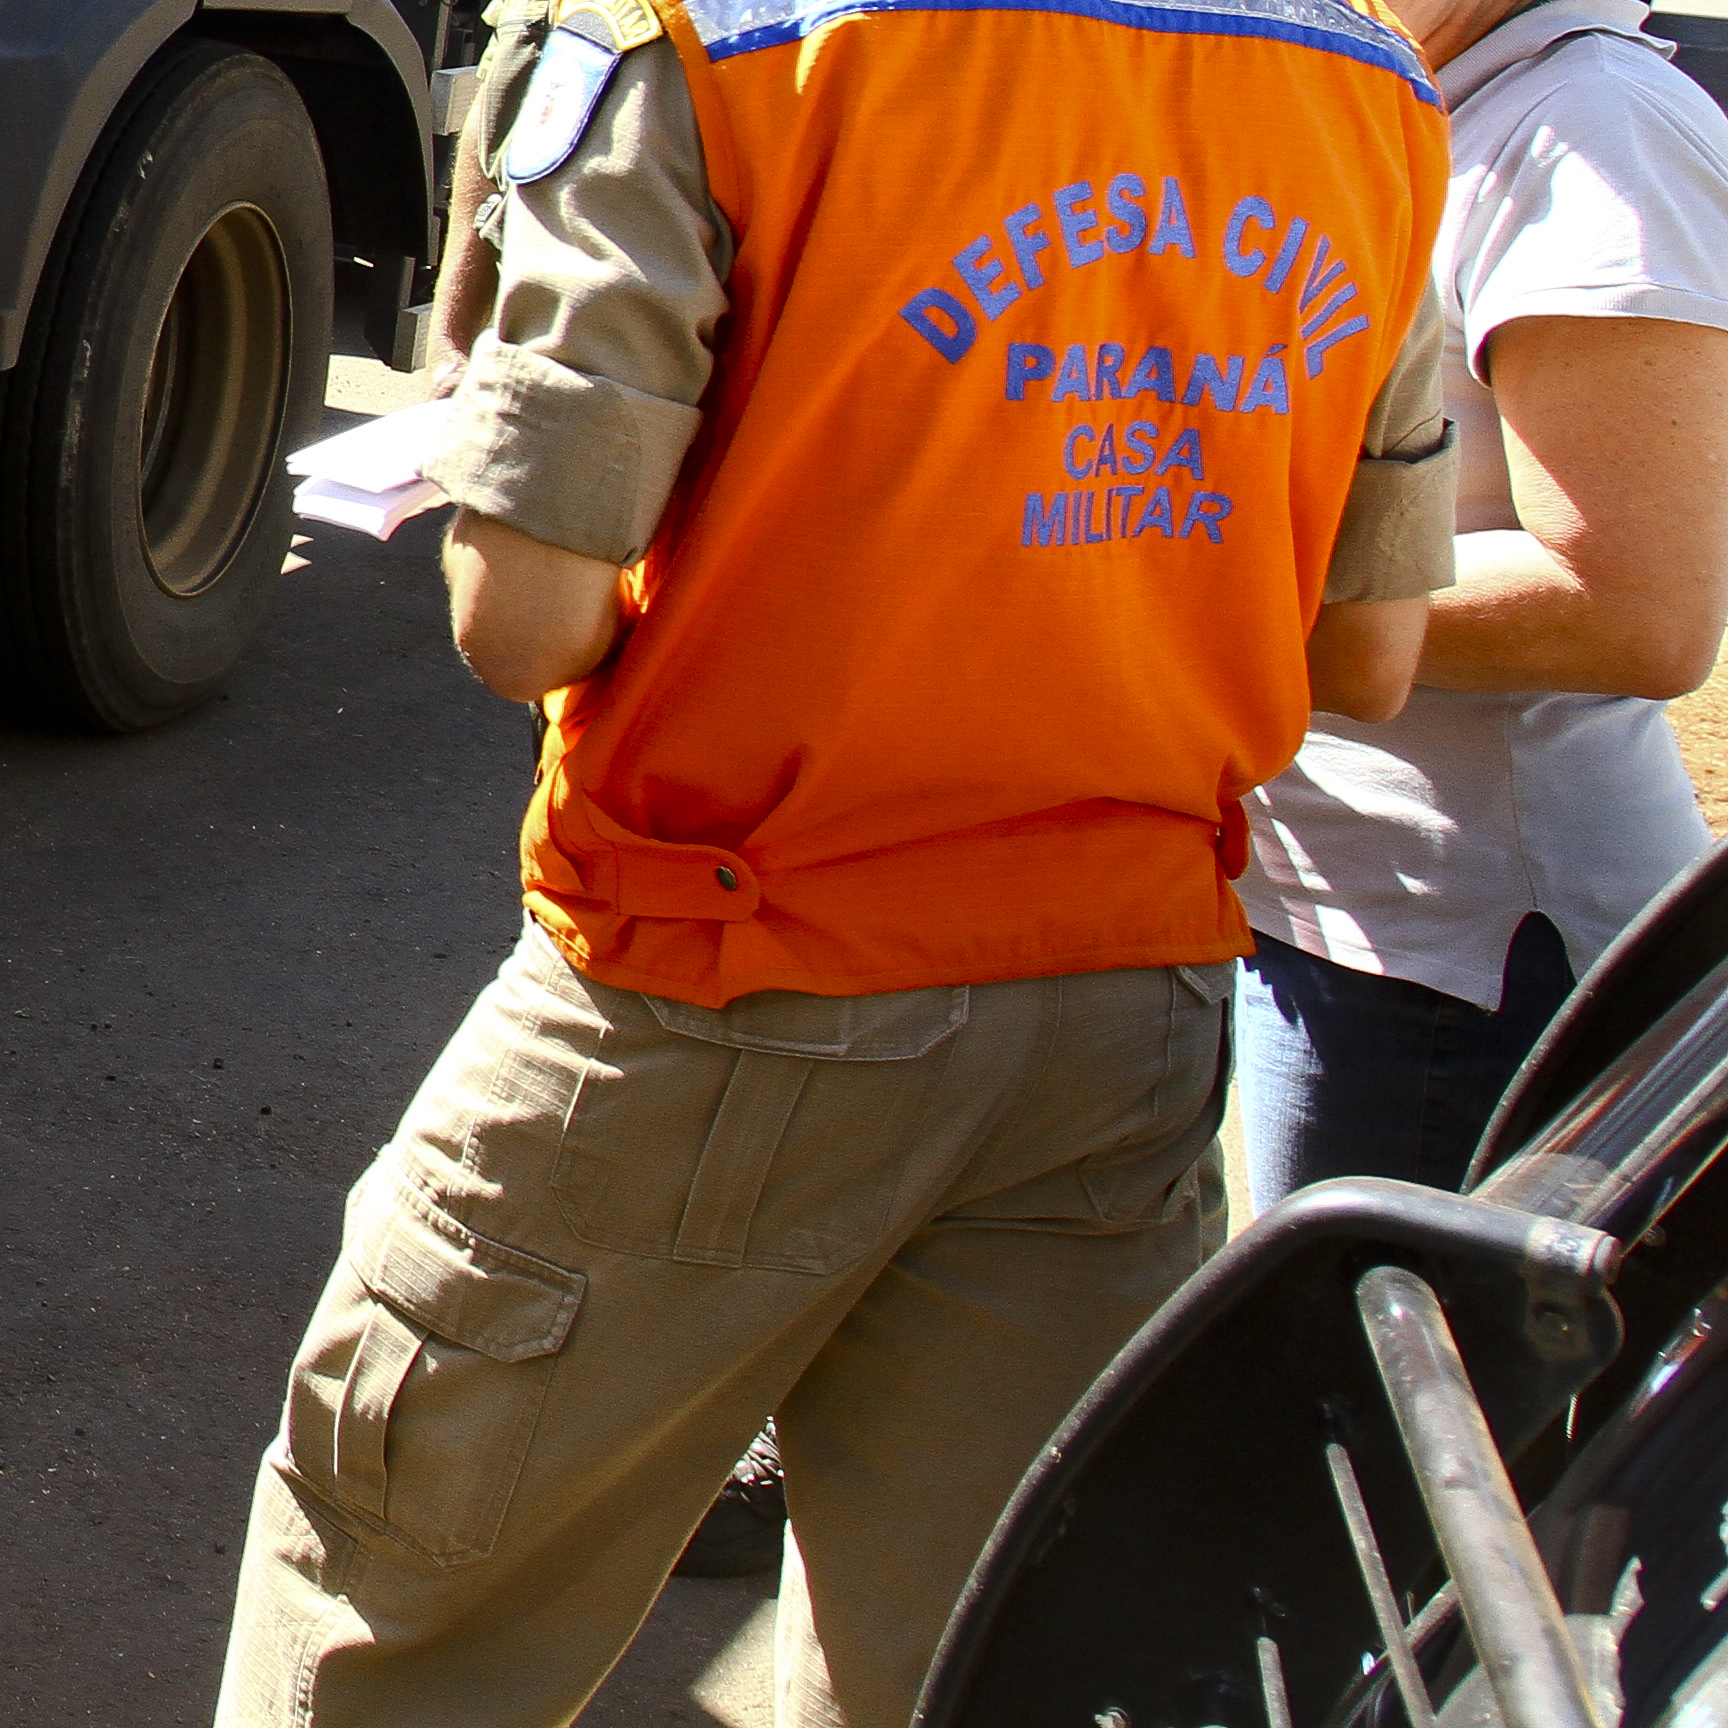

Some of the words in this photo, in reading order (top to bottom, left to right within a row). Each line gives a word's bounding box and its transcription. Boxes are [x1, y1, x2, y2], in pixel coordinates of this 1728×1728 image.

[898, 173, 1196, 365] DEFESA
[1223, 196, 1370, 380] CIVIL
[1005, 343, 1290, 415] PARANÁ
[1063, 421, 1204, 480] CASA
[1021, 485, 1233, 547] MILITAR
